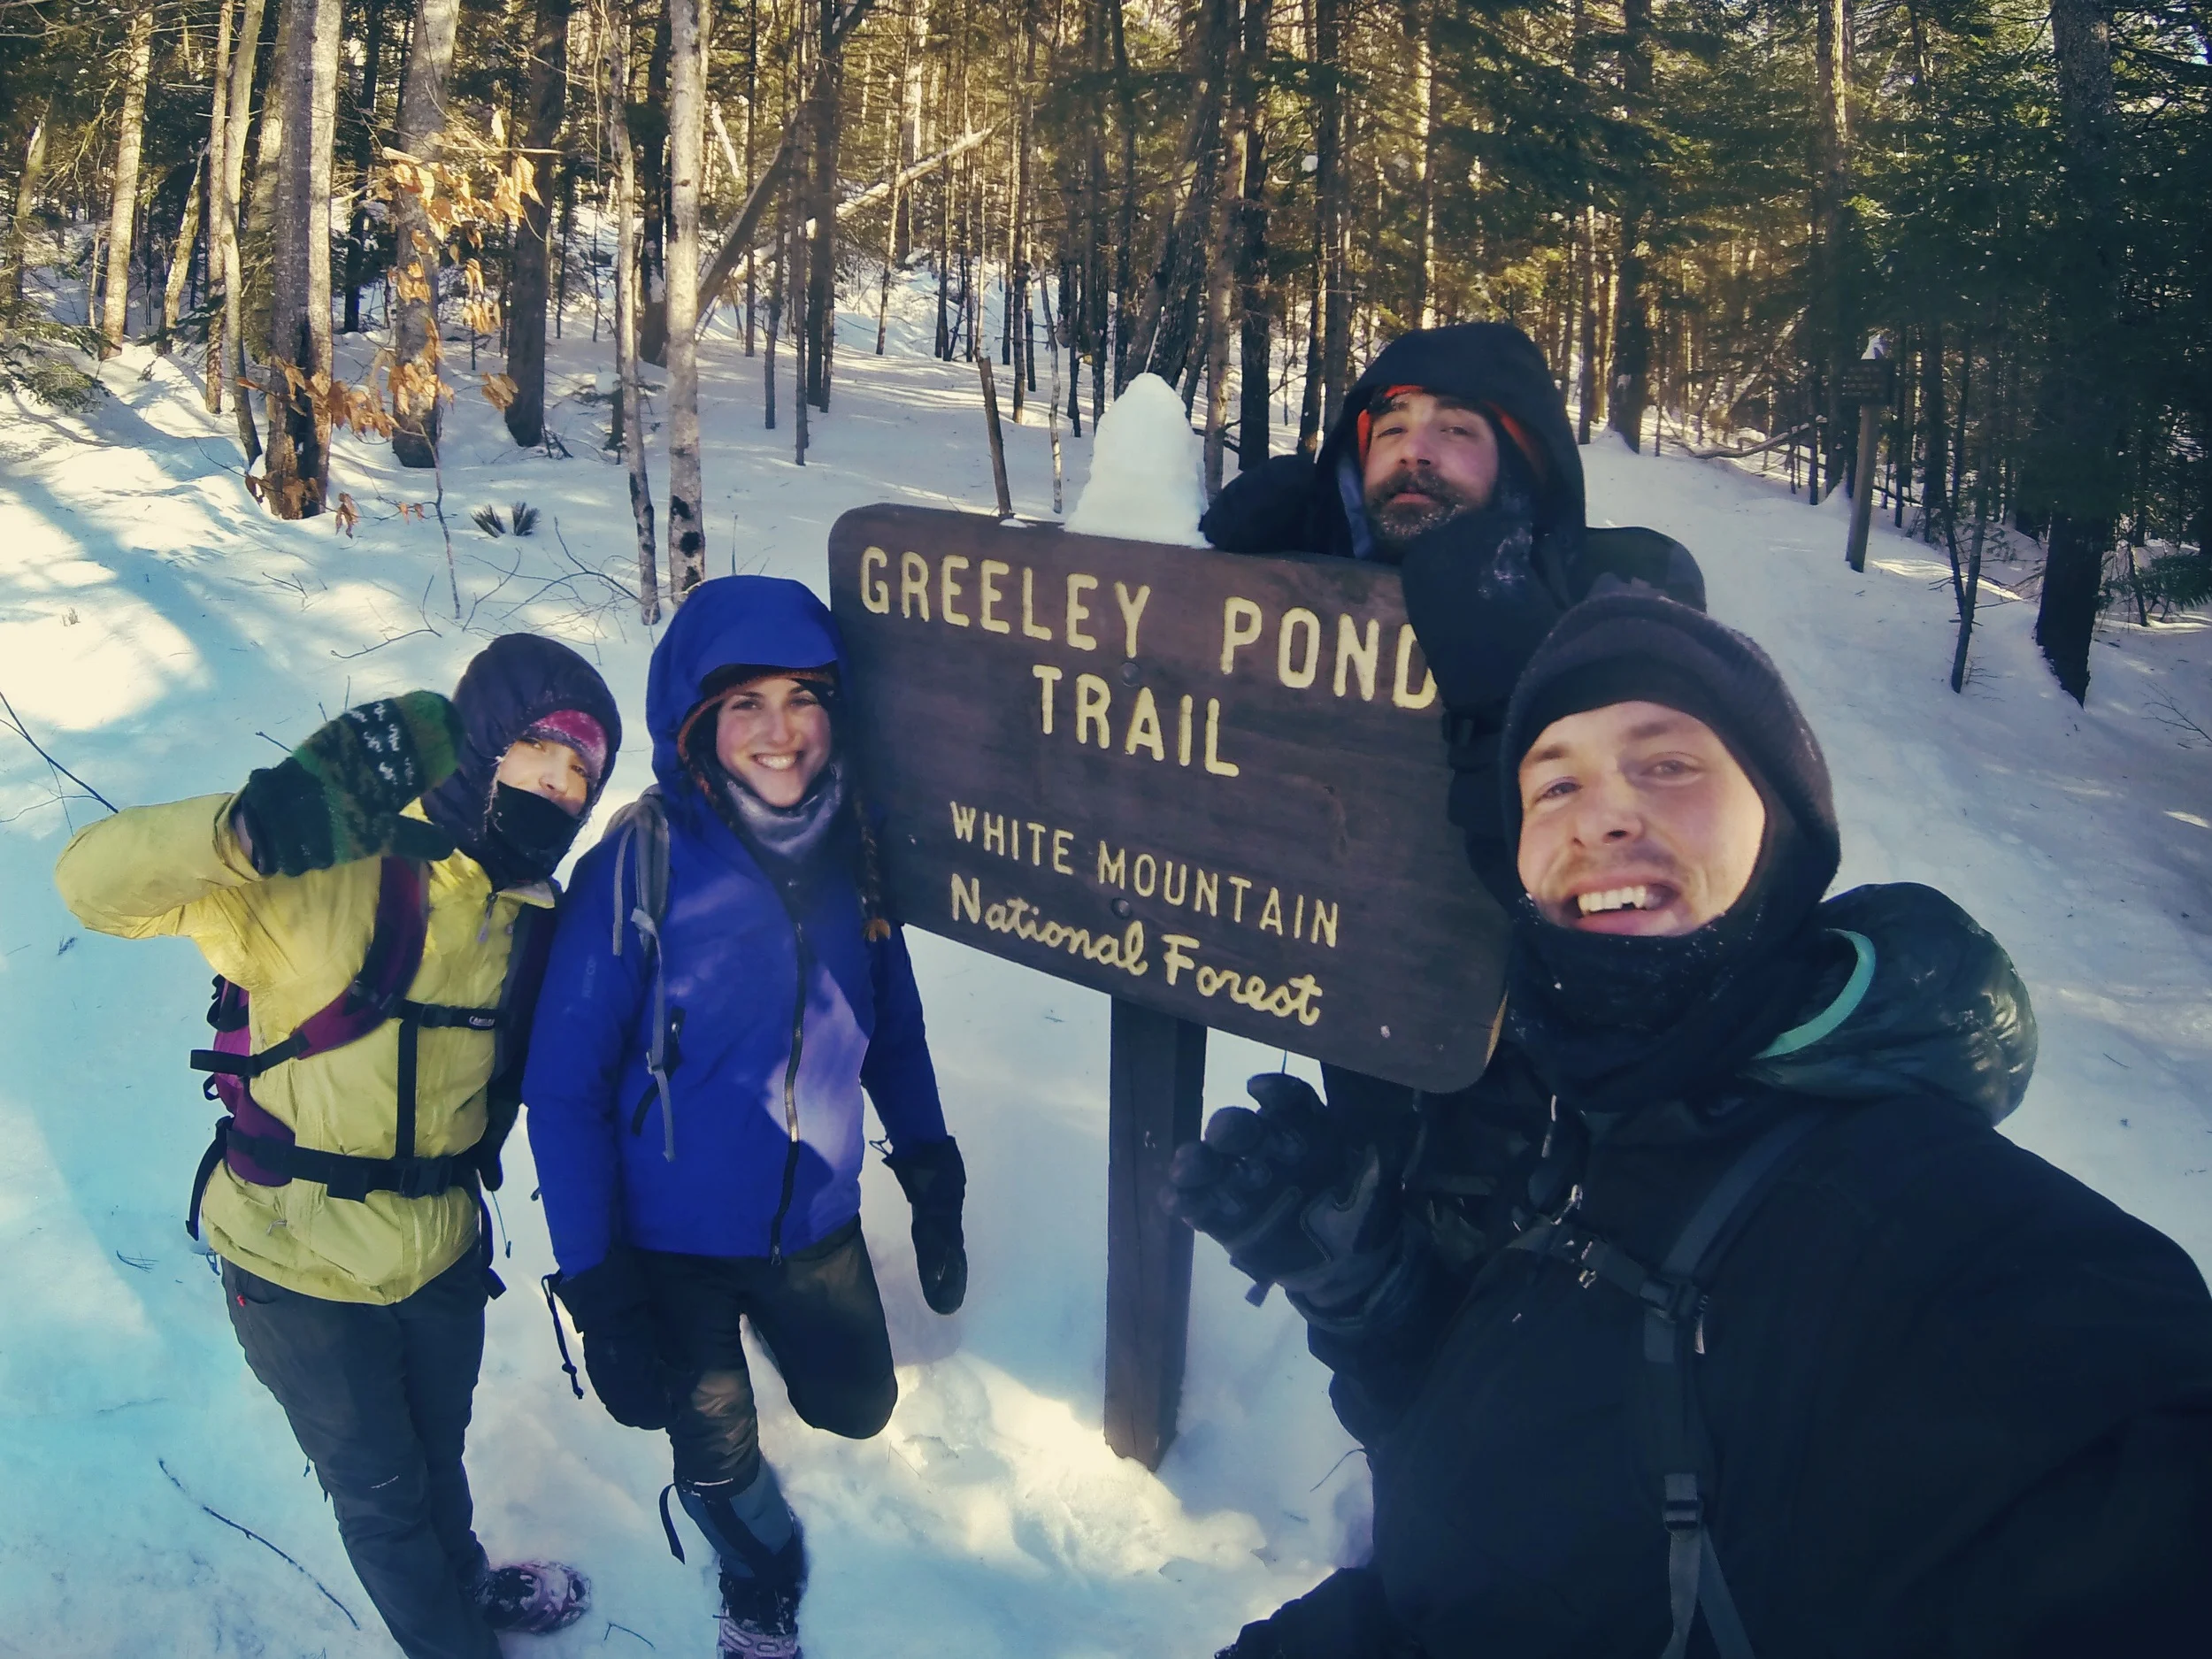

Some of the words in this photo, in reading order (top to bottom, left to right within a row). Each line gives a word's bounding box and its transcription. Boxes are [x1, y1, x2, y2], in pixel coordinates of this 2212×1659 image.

[859, 545, 1152, 658] GREELEY
[1218, 595, 1439, 710] POND
[1032, 664, 1240, 779] TRAIL
[949, 801, 1074, 875] WHITE
[1097, 841, 1339, 948] MOUNTAIN
[950, 873, 1149, 976] National
[1161, 933, 1324, 1026] Forest
